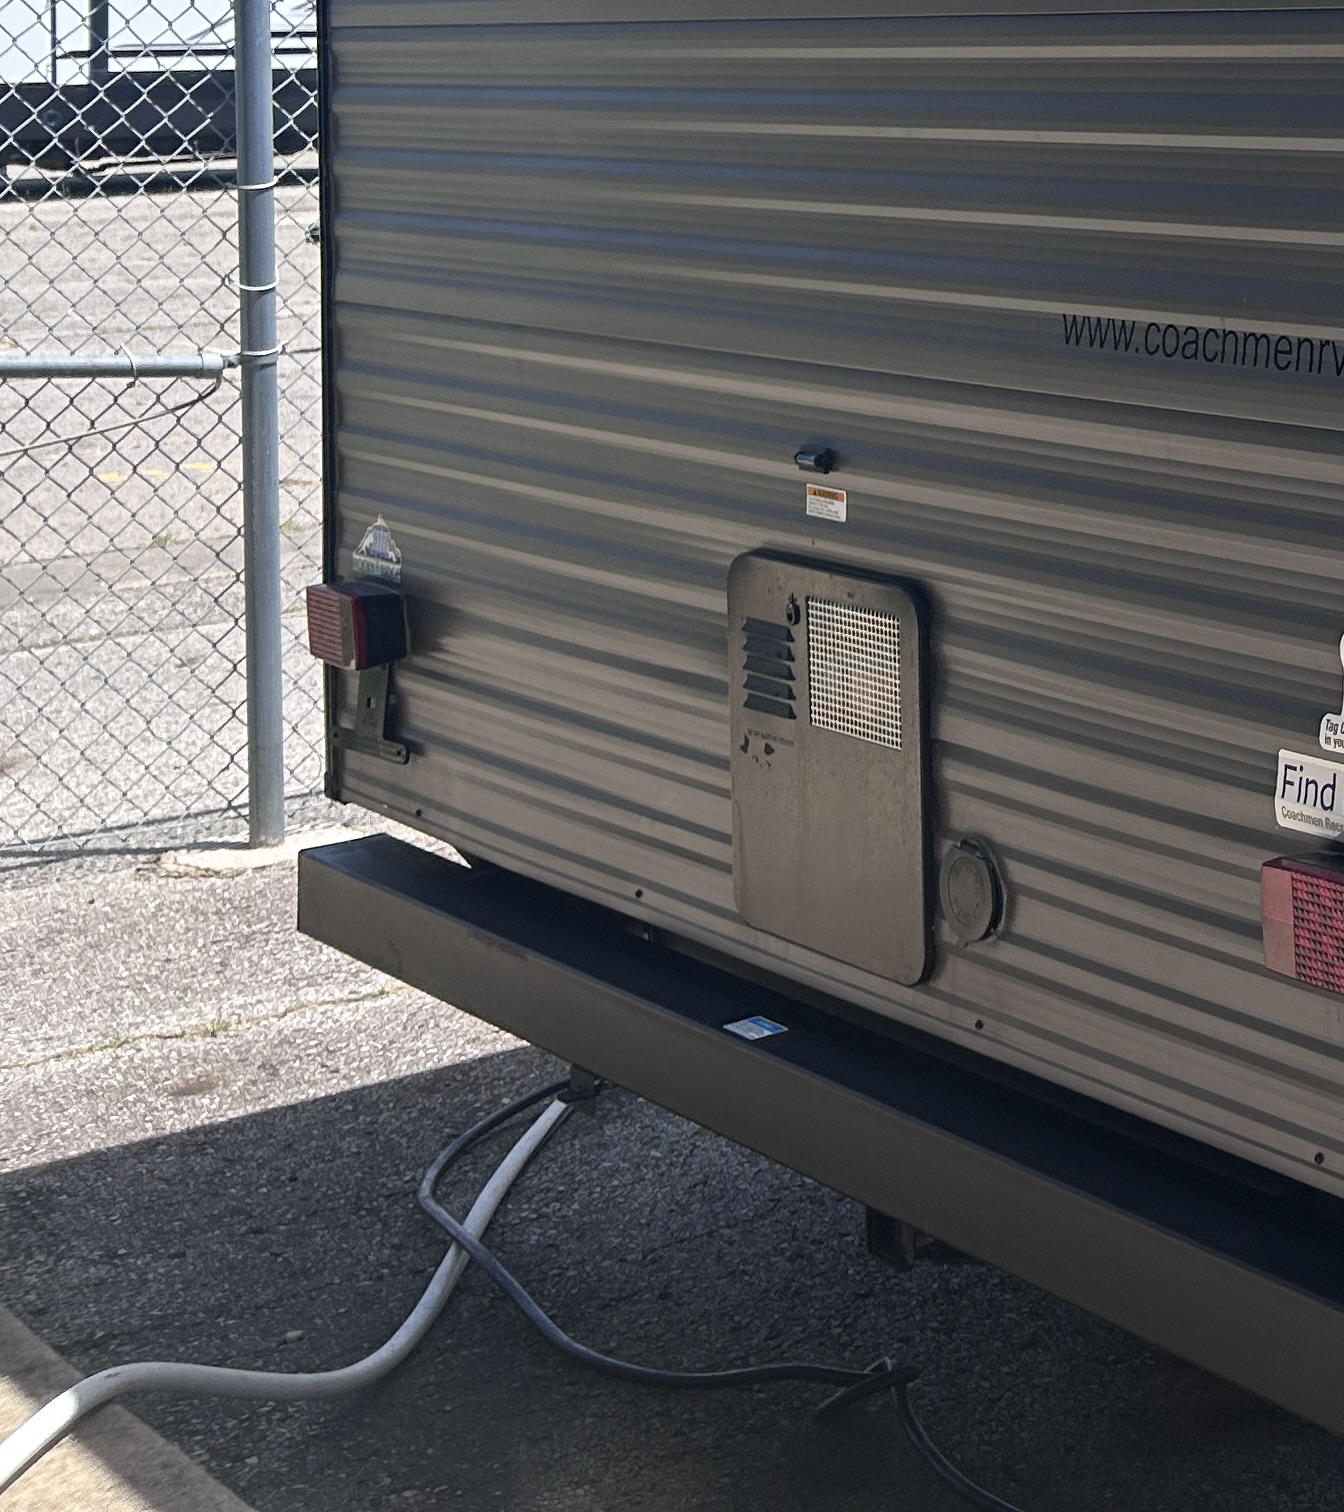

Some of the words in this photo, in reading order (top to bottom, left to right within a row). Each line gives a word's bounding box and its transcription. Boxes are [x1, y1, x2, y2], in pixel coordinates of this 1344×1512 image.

[1325, 718, 1339, 736] Tag
[1324, 733, 1331, 746] in
[1281, 763, 1337, 811] Find
[1281, 805, 1324, 828] Coachmen
